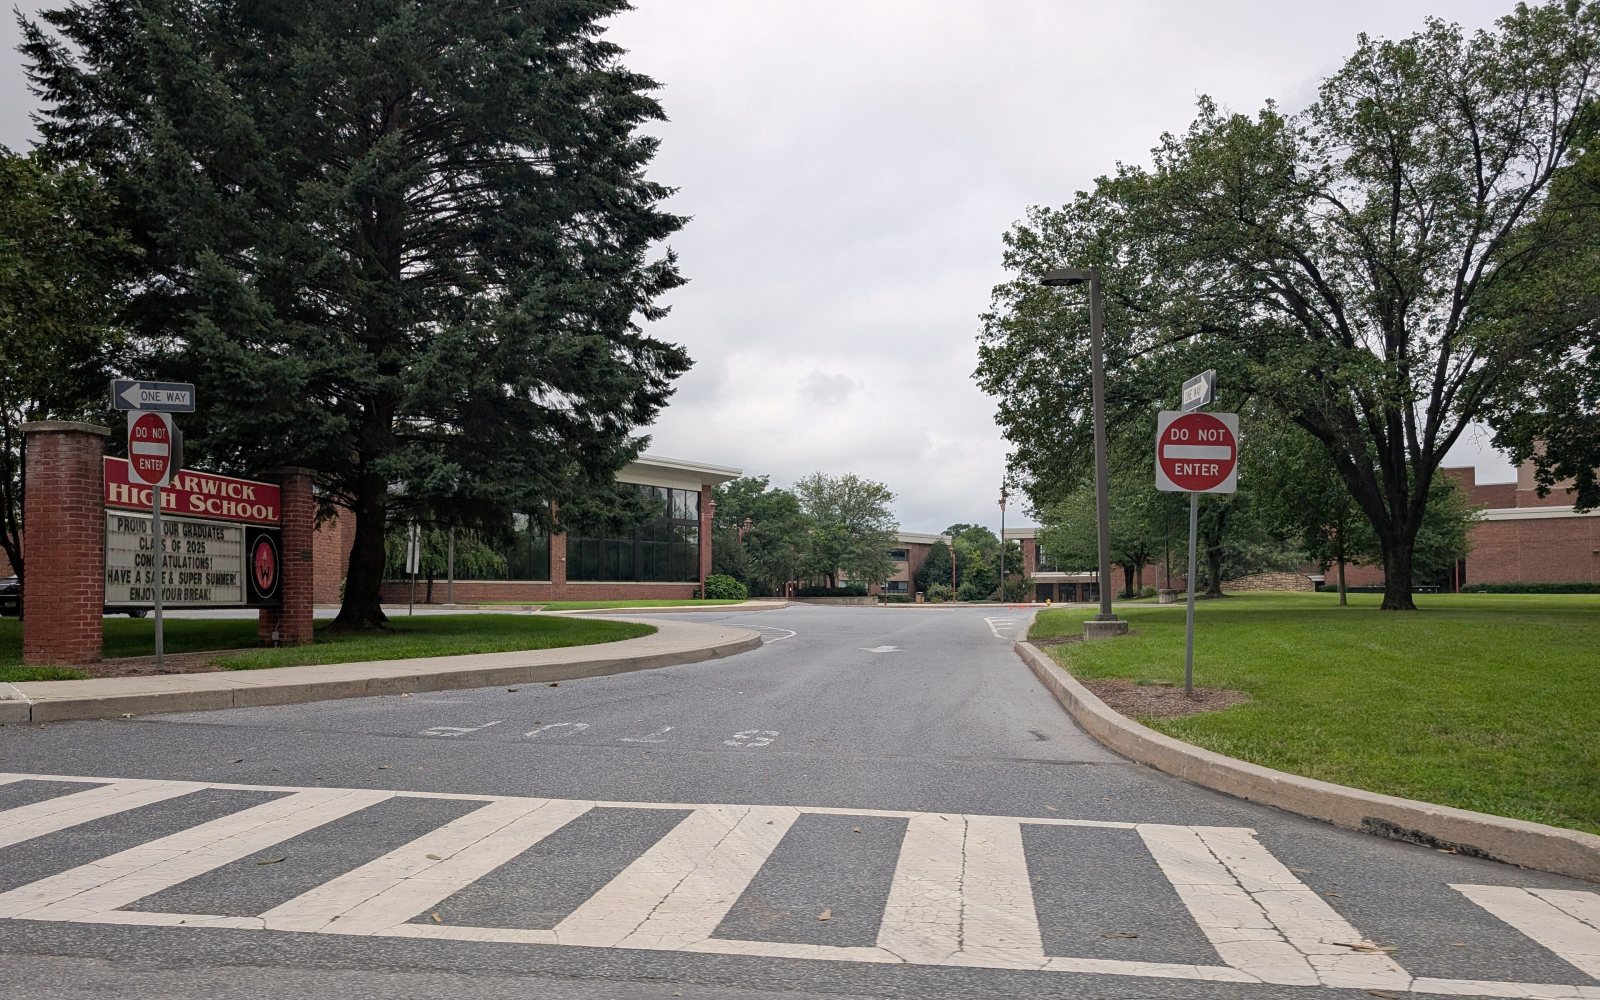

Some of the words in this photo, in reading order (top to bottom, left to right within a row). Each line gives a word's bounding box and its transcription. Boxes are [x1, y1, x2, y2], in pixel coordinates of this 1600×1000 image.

[141, 391, 161, 402] ONE
[166, 392, 186, 403] WAY
[136, 427, 147, 438] DO
[152, 428, 166, 439] NOT
[1171, 428, 1189, 441] DO
[1198, 429, 1225, 441] NOT
[140, 459, 163, 471] ENTER
[1175, 463, 1219, 476] ENTER
[168, 474, 256, 500] ARWICK
[189, 494, 279, 521] SCHOOL
[117, 517, 147, 533] PROUD
[163, 522, 179, 537] OUR
[182, 525, 225, 540] GRADUATES
[139, 537, 166, 551] CLAS
[171, 539, 181, 552] OF
[186, 541, 206, 554] 2025
[107, 569, 131, 583] HAVE
[135, 570, 141, 583] A
[145, 570, 166, 584] SAE
[168, 571, 174, 584] &
[178, 571, 203, 585] SUPER
[130, 587, 156, 601] ENJOY
[162, 588, 182, 601] YOUR
[184, 588, 211, 601] BREAK!
